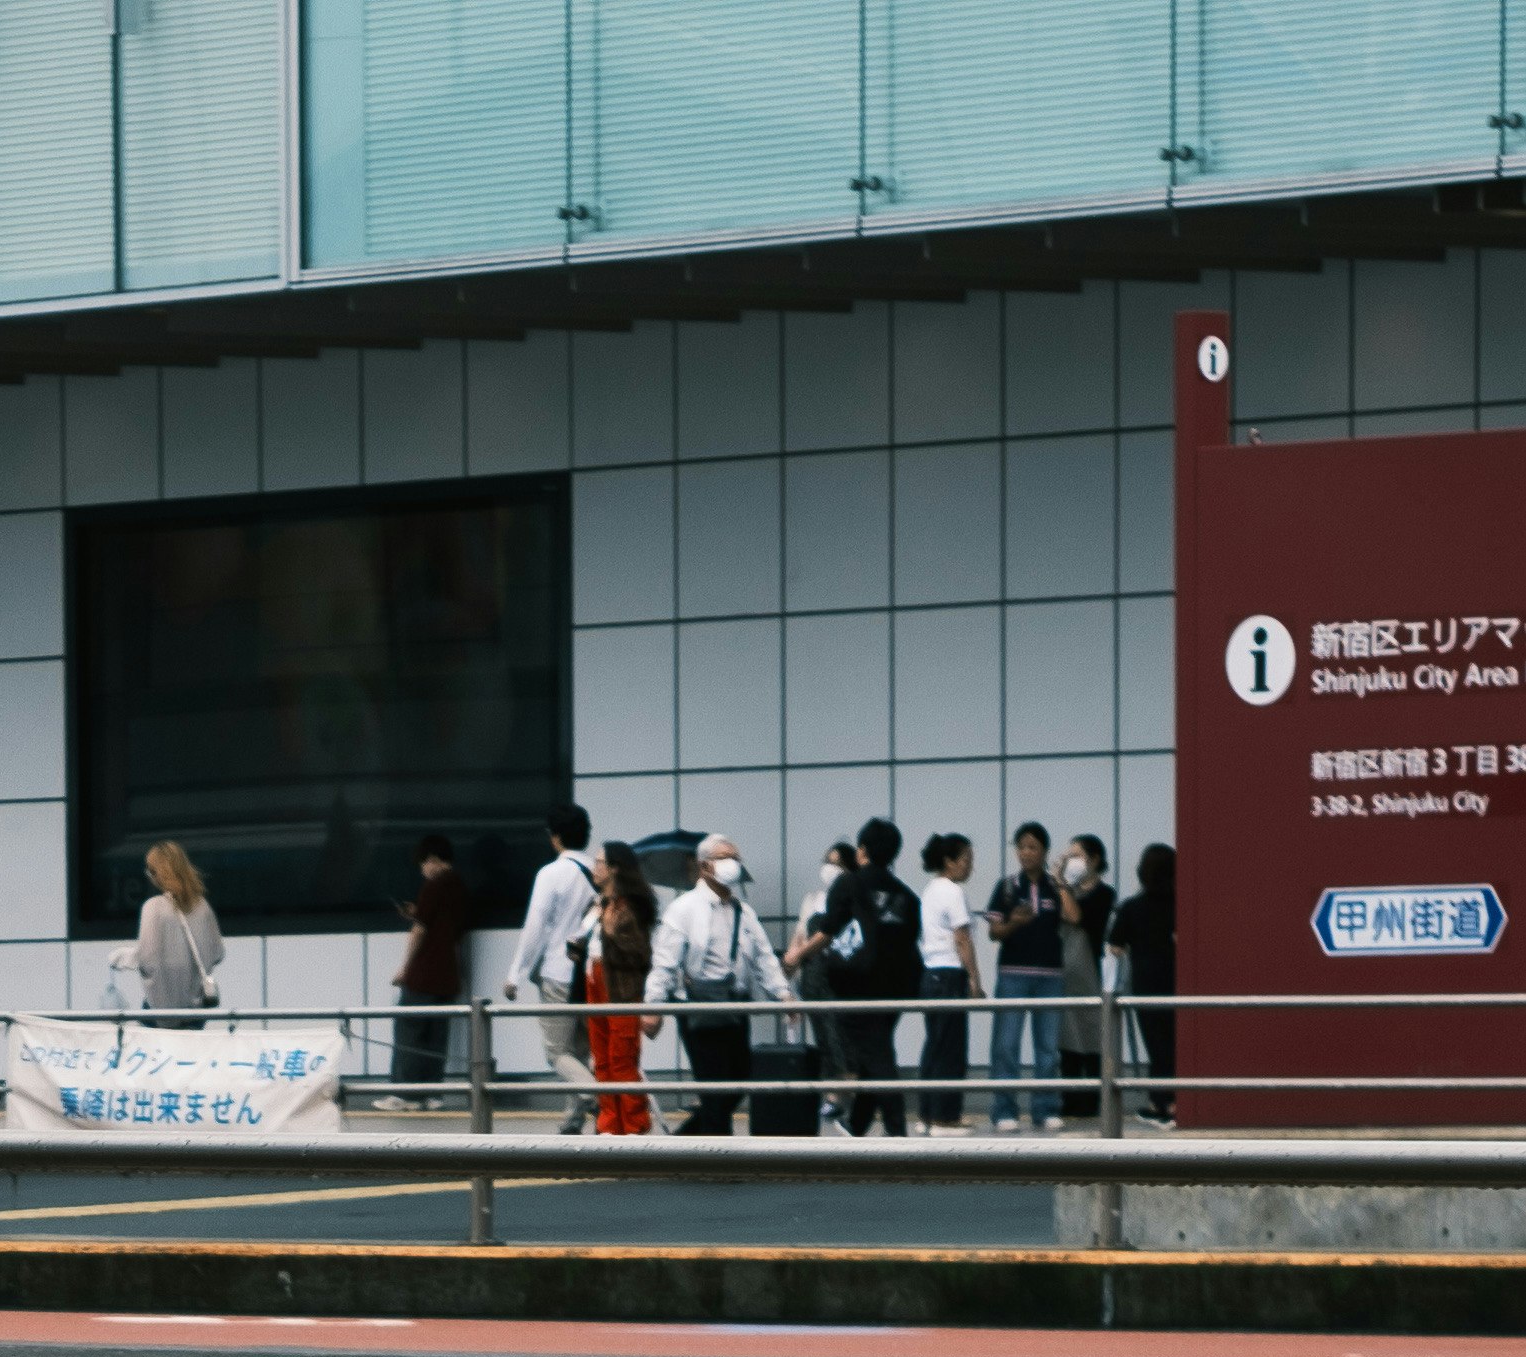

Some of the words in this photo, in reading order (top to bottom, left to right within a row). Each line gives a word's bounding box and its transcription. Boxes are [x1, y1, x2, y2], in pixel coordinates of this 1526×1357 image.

[1311, 615, 1526, 660] 新宿区エリアマ
[1311, 666, 1408, 699] Shinjuku
[1413, 664, 1460, 696] City
[1463, 661, 1520, 687] Area
[1372, 791, 1450, 817] Shinjuku
[1453, 790, 1490, 817] City
[1335, 900, 1487, 941] 甲州街道
[59, 1087, 263, 1127] 乗降は出来ません
